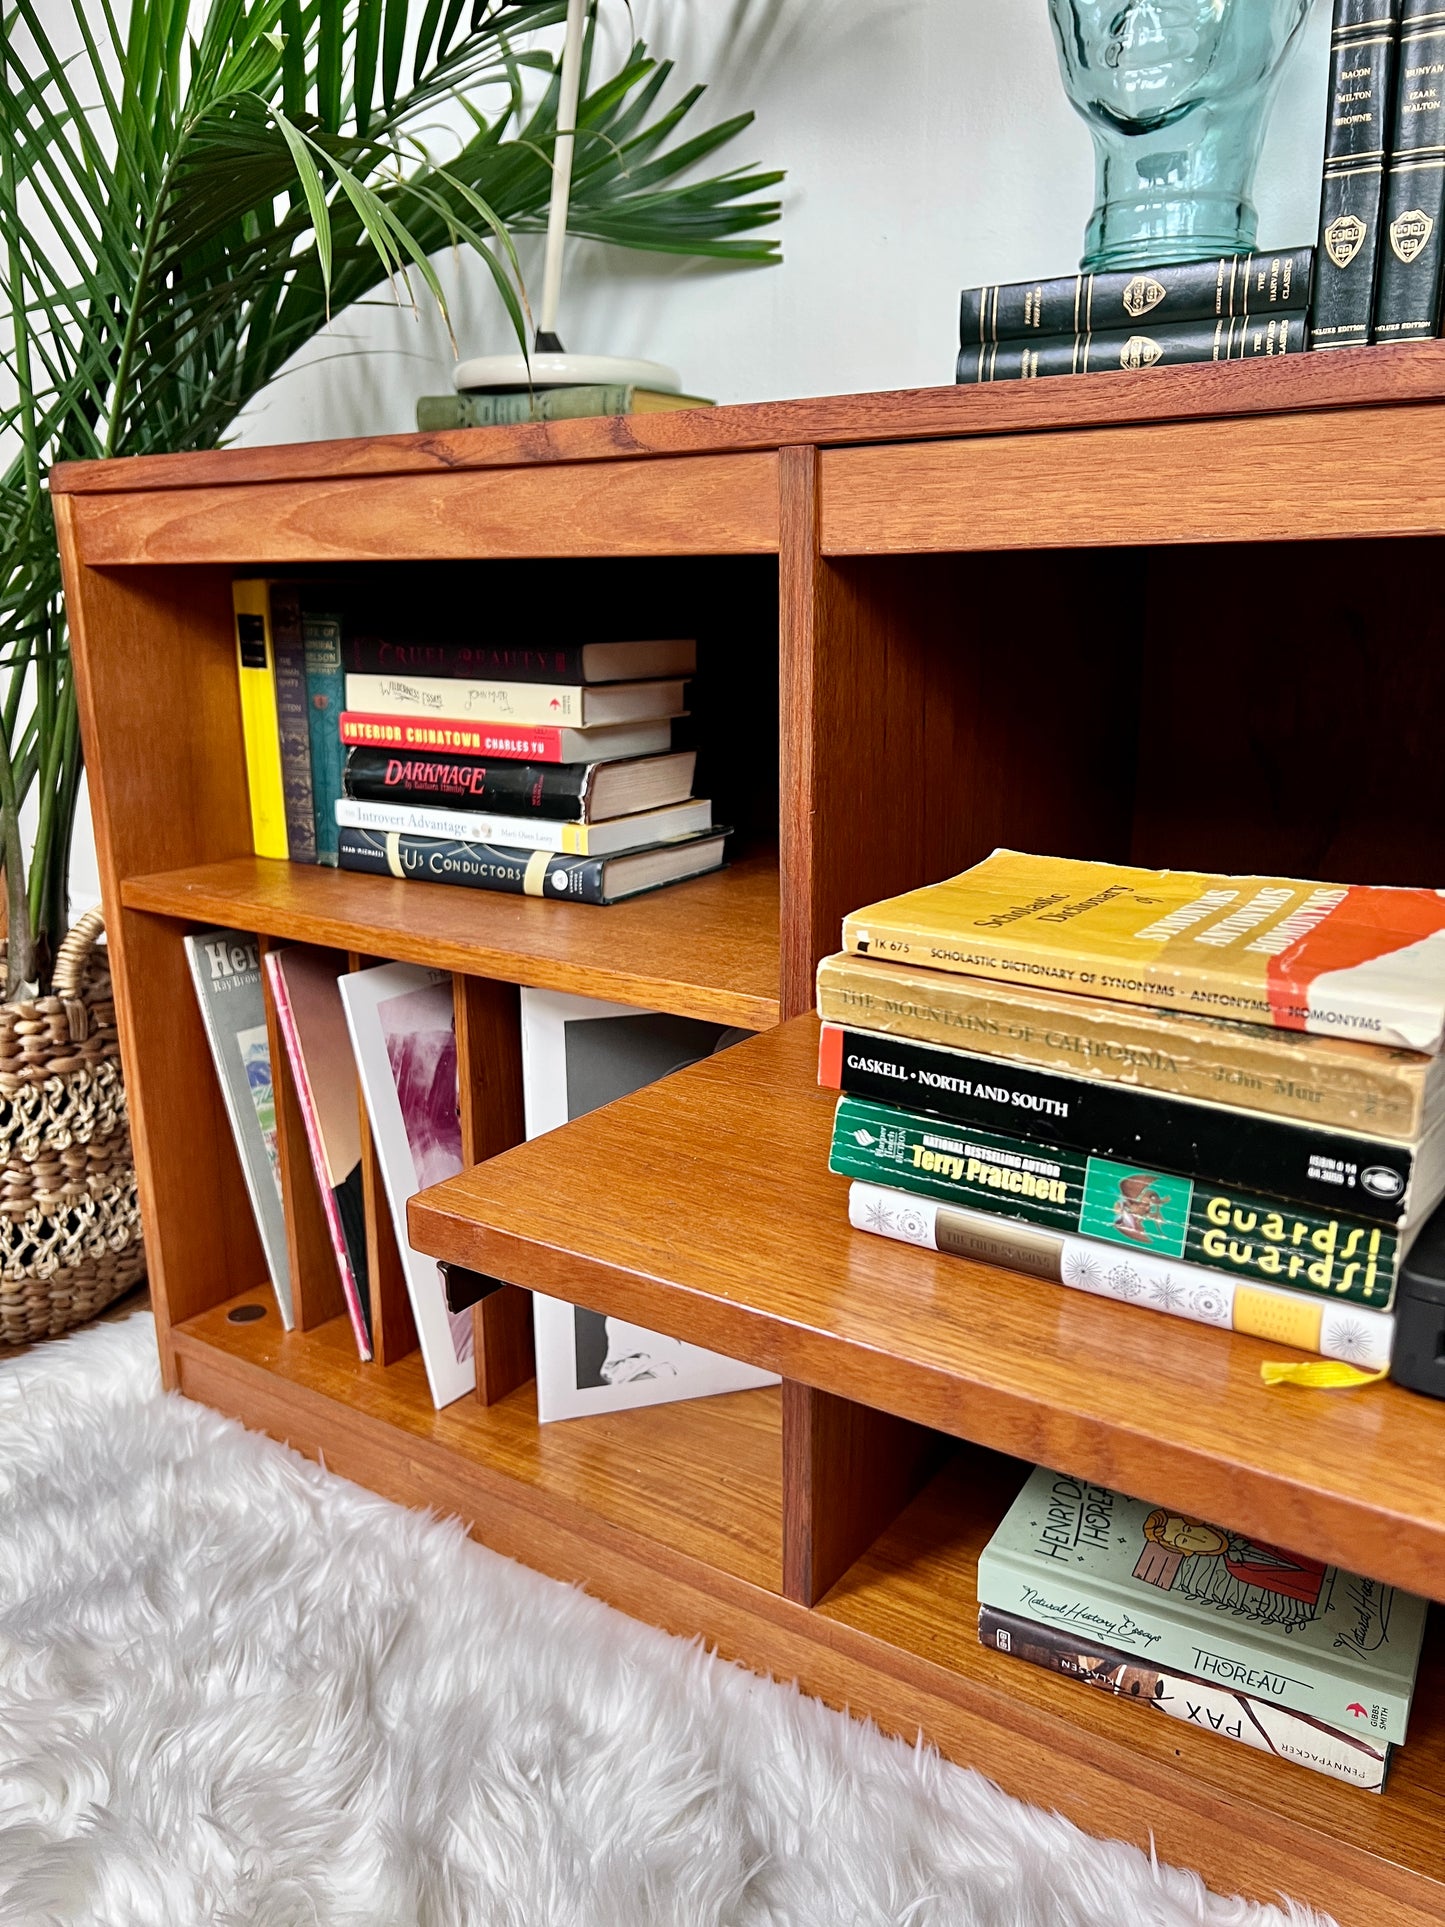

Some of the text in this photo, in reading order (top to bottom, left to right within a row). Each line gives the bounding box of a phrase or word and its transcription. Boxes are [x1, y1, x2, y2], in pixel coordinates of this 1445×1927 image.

[1341, 67, 1371, 80] BACON
[1405, 64, 1444, 78] BUNYAN
[1338, 90, 1372, 103] MILTON
[1402, 101, 1441, 112] WALTON
[1409, 88, 1436, 100] IZAAK
[1334, 113, 1372, 126] BROWNE
[1258, 272, 1266, 291] THE
[1270, 258, 1280, 302] HARVARD
[1282, 258, 1293, 300] CLASSICS
[1266, 321, 1276, 356] ARVARD
[344, 722, 544, 754] INTERIOR CHINATOWN CHARLES YU
[384, 759, 486, 794] DARKMAGE
[357, 807, 405, 826] Introvert
[408, 813, 467, 837] Advantage
[429, 854, 521, 881] CONDUCTORS
[974, 892, 1071, 929] Scholastic
[1037, 884, 1135, 923] Dictionary
[1133, 894, 1164, 905] of
[1133, 888, 1240, 942] SYNONYMS
[1193, 887, 1296, 947] ANTONYMS
[1243, 888, 1350, 956] HOMONYMS
[212, 978, 232, 993] Ray
[890, 940, 911, 954] 675
[931, 948, 997, 968] SCHOLASTIC
[1001, 959, 1075, 980] DICTIONARY
[1080, 972, 1096, 984] OF
[1100, 975, 1176, 997] SYNONYMS
[1190, 990, 1272, 1013] ANTONYMS
[1288, 1005, 1382, 1032] HOMONYMS
[840, 989, 1325, 1104] THE MOUNTAINS OF CALIFORNIA John Muir
[847, 1054, 1069, 1118] GASKELL NORTH AND SOUTH
[895, 1129, 908, 1164] FICTION
[922, 1134, 1061, 1178] NATIONAL BESTSELLING AUTHOR
[912, 1144, 1068, 1205] Terry Pratchett
[1206, 1196, 1382, 1262] Guards!
[1202, 1228, 1378, 1297] Guards!
[1034, 1497, 1075, 1562] HENRY
[1020, 1584, 1162, 1648] Natural History Essays
[1338, 1608, 1372, 1660] Natural
[1192, 1647, 1287, 1695] THOREAU
[1062, 1659, 1366, 1779] PENNYPACKER PAX KLASSEN
[1371, 1704, 1380, 1727] GIBBS
[1379, 1707, 1388, 1730] SMITH
